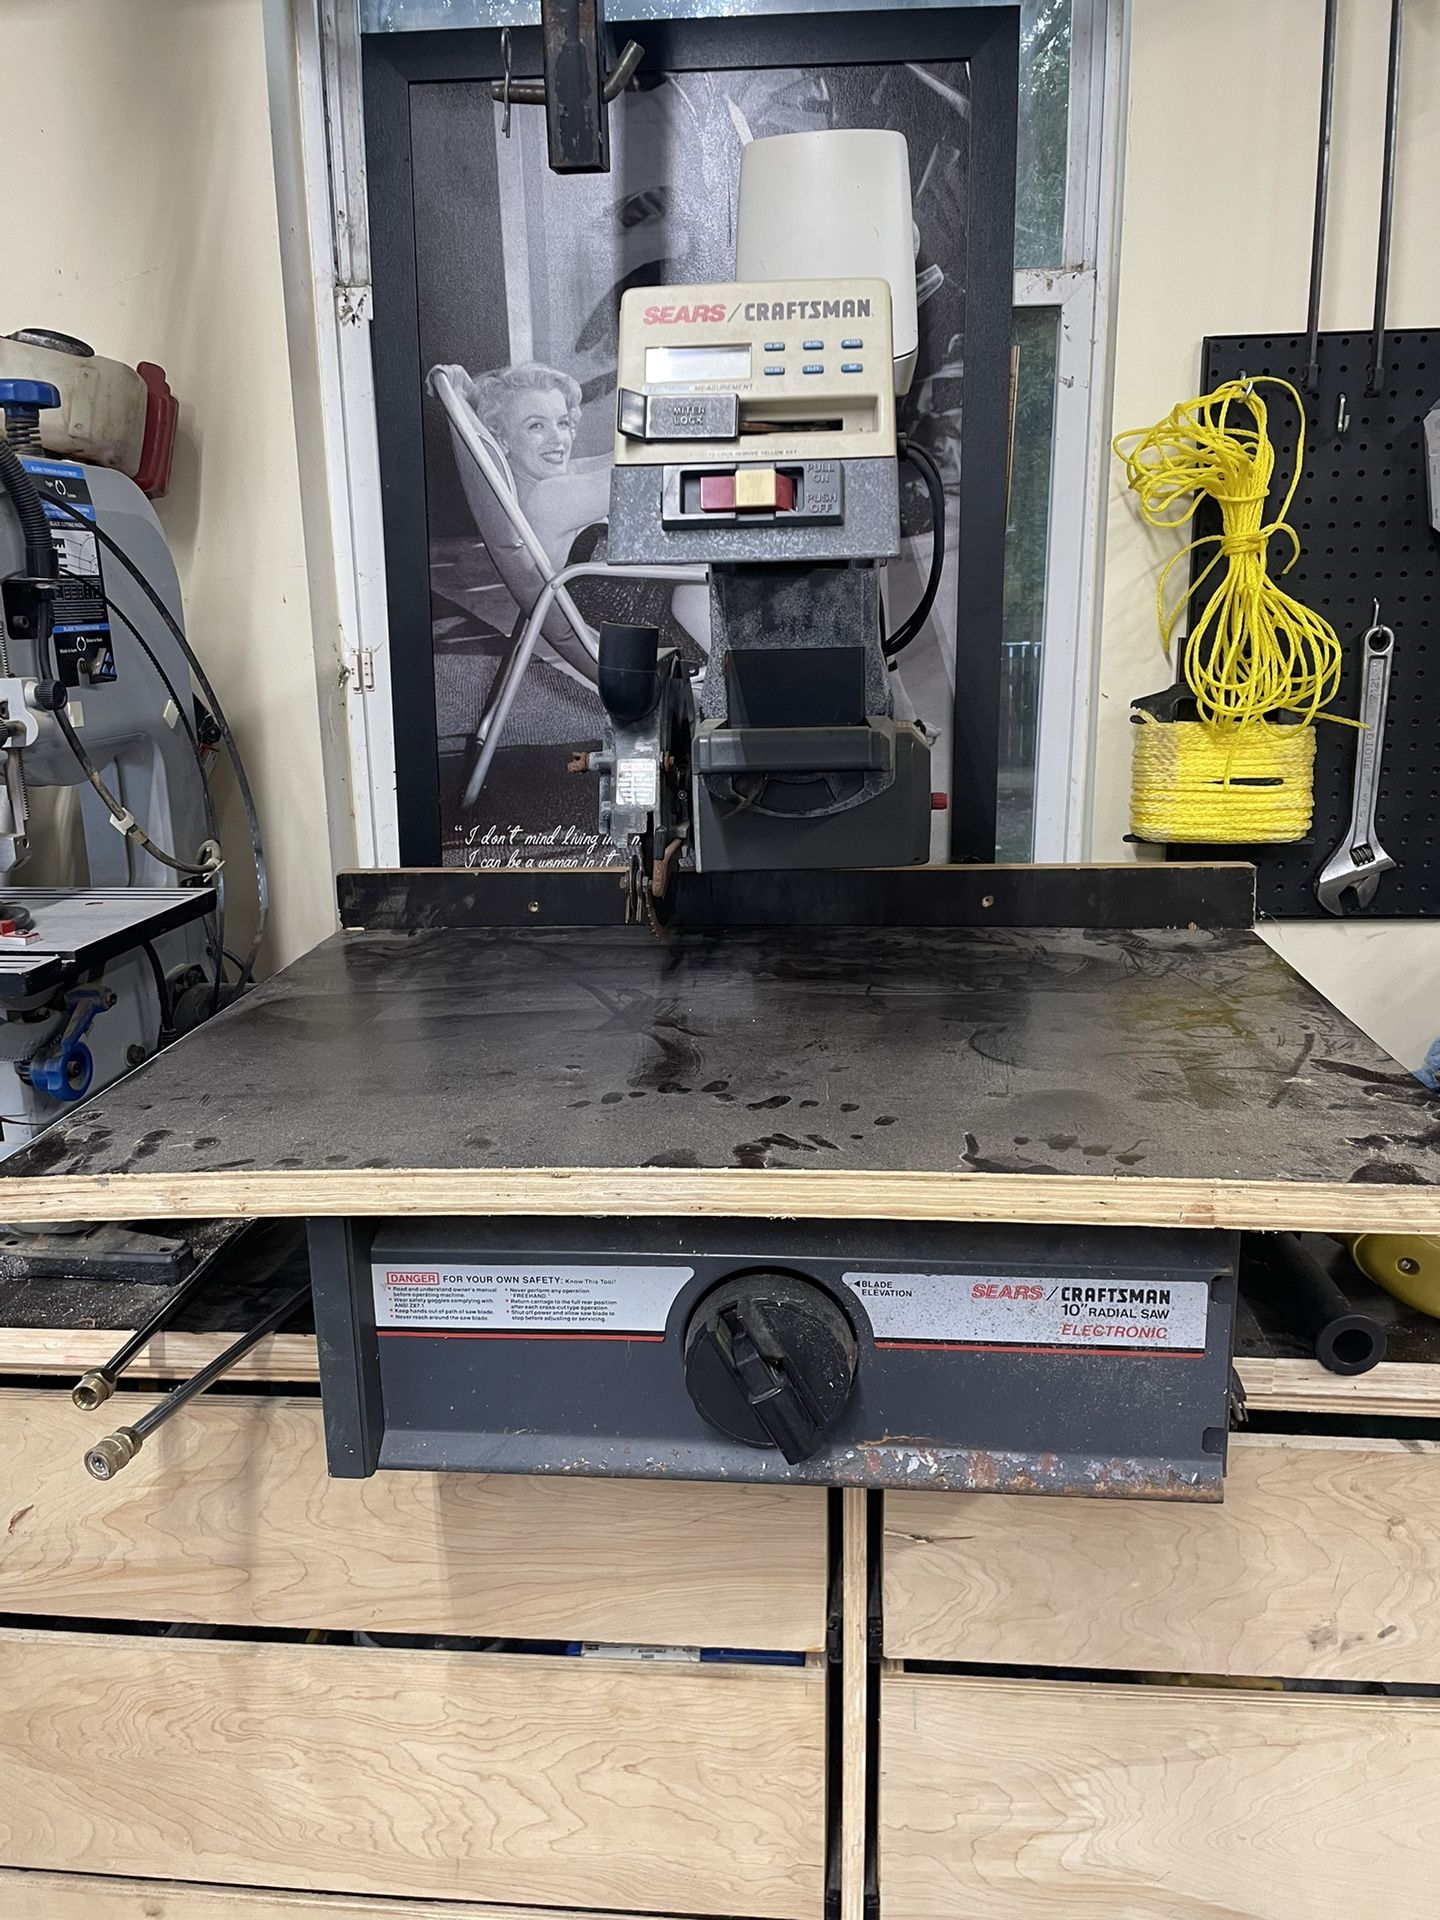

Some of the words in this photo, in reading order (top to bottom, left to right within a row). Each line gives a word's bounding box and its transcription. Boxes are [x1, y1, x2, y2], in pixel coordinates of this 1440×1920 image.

[643, 304, 726, 325] SEARS
[744, 299, 871, 322] CRAFTSMAN
[694, 383, 754, 391] MEASUREMENT
[673, 407, 706, 415] MITER
[673, 416, 704, 426] LOCK
[807, 463, 835, 473] PULL
[813, 474, 830, 483] ON
[807, 493, 837, 503] PUSH
[810, 504, 833, 514] OFF
[524, 825, 562, 845] mind
[562, 825, 598, 854] living
[480, 857, 501, 868] can
[505, 850, 522, 868] be
[525, 858, 533, 868] a
[538, 858, 579, 868] woman
[582, 856, 595, 868] in
[391, 1274, 436, 1283] DANGER
[443, 1275, 463, 1283] FOR
[466, 1275, 493, 1284] YOUR
[496, 1275, 519, 1284] OWN
[522, 1275, 563, 1284] SAFETY:
[862, 1289, 912, 1297] ELEVATION
[971, 1284, 1044, 1300] SEARS
[1062, 1287, 1171, 1305] CRAFTSMAN
[1089, 1307, 1136, 1319] RADIAL
[1140, 1309, 1170, 1320] SAW
[1061, 1324, 1168, 1339] ELECTRONIC
